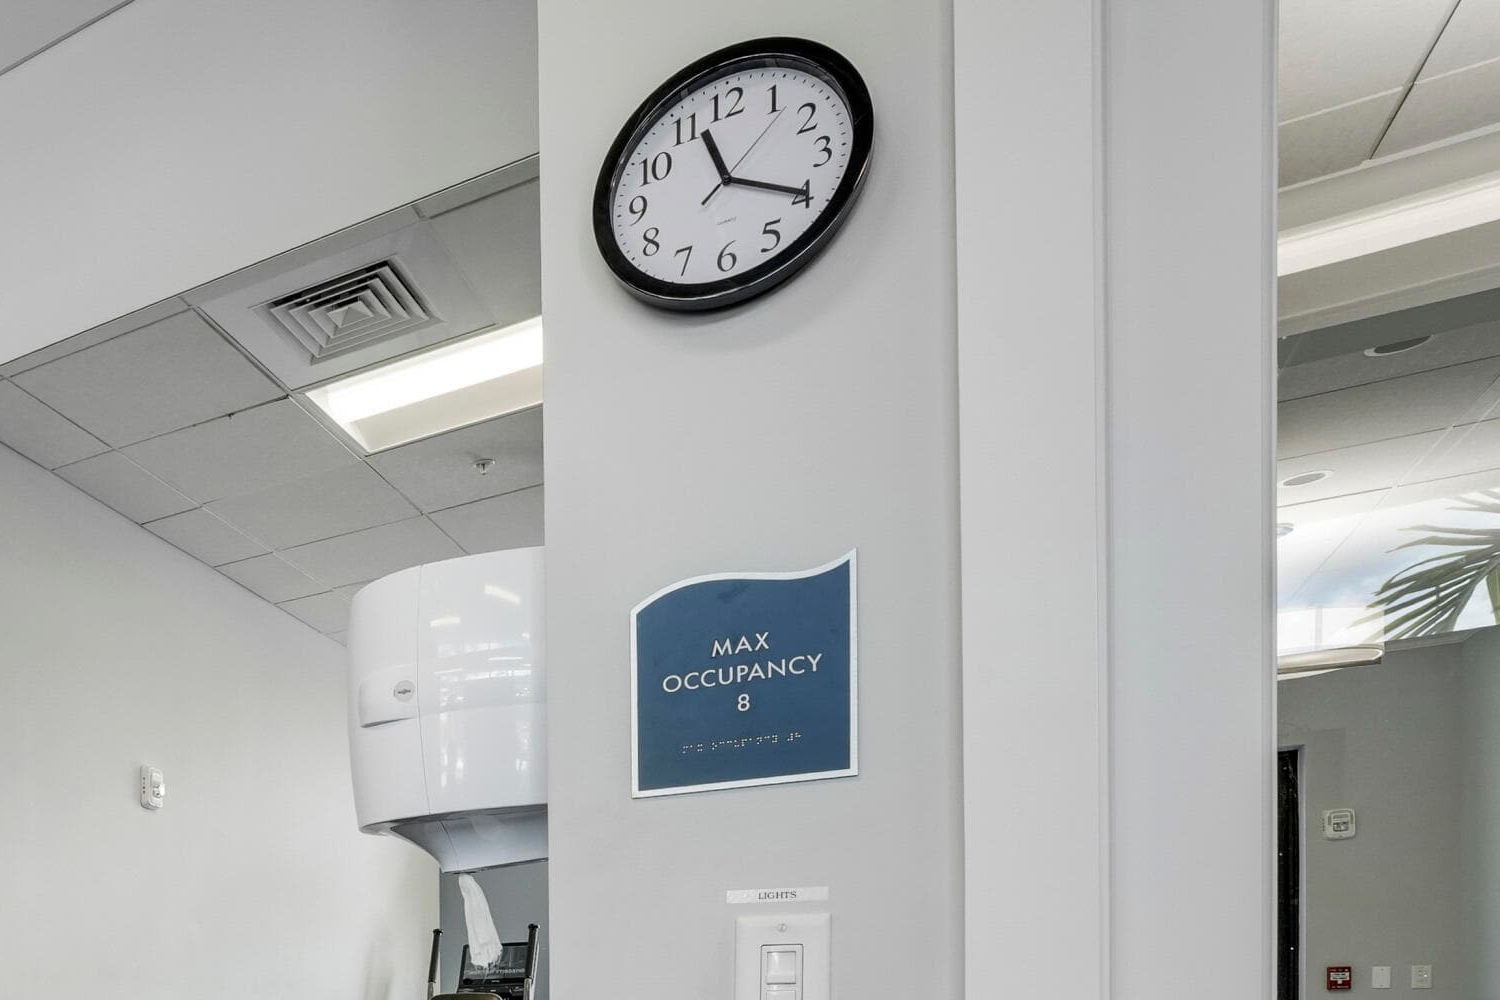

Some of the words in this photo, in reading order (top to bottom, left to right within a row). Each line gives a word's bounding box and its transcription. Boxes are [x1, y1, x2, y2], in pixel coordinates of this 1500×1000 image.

[709, 87, 745, 123] 12
[766, 84, 782, 115] 1
[672, 112, 700, 147] 11
[796, 102, 818, 135] 2
[813, 135, 833, 167] 3
[638, 151, 672, 187] 10
[791, 179, 814, 209] 4
[628, 195, 648, 226] 9
[642, 227, 660, 256] 8
[760, 218, 782, 253] 5
[674, 245, 693, 276] 7
[716, 239, 737, 272] 6
[711, 632, 770, 658] MAX
[662, 653, 822, 693] OCCUPANCY
[737, 694, 751, 712] 8
[758, 891, 797, 900] LIGHTS
